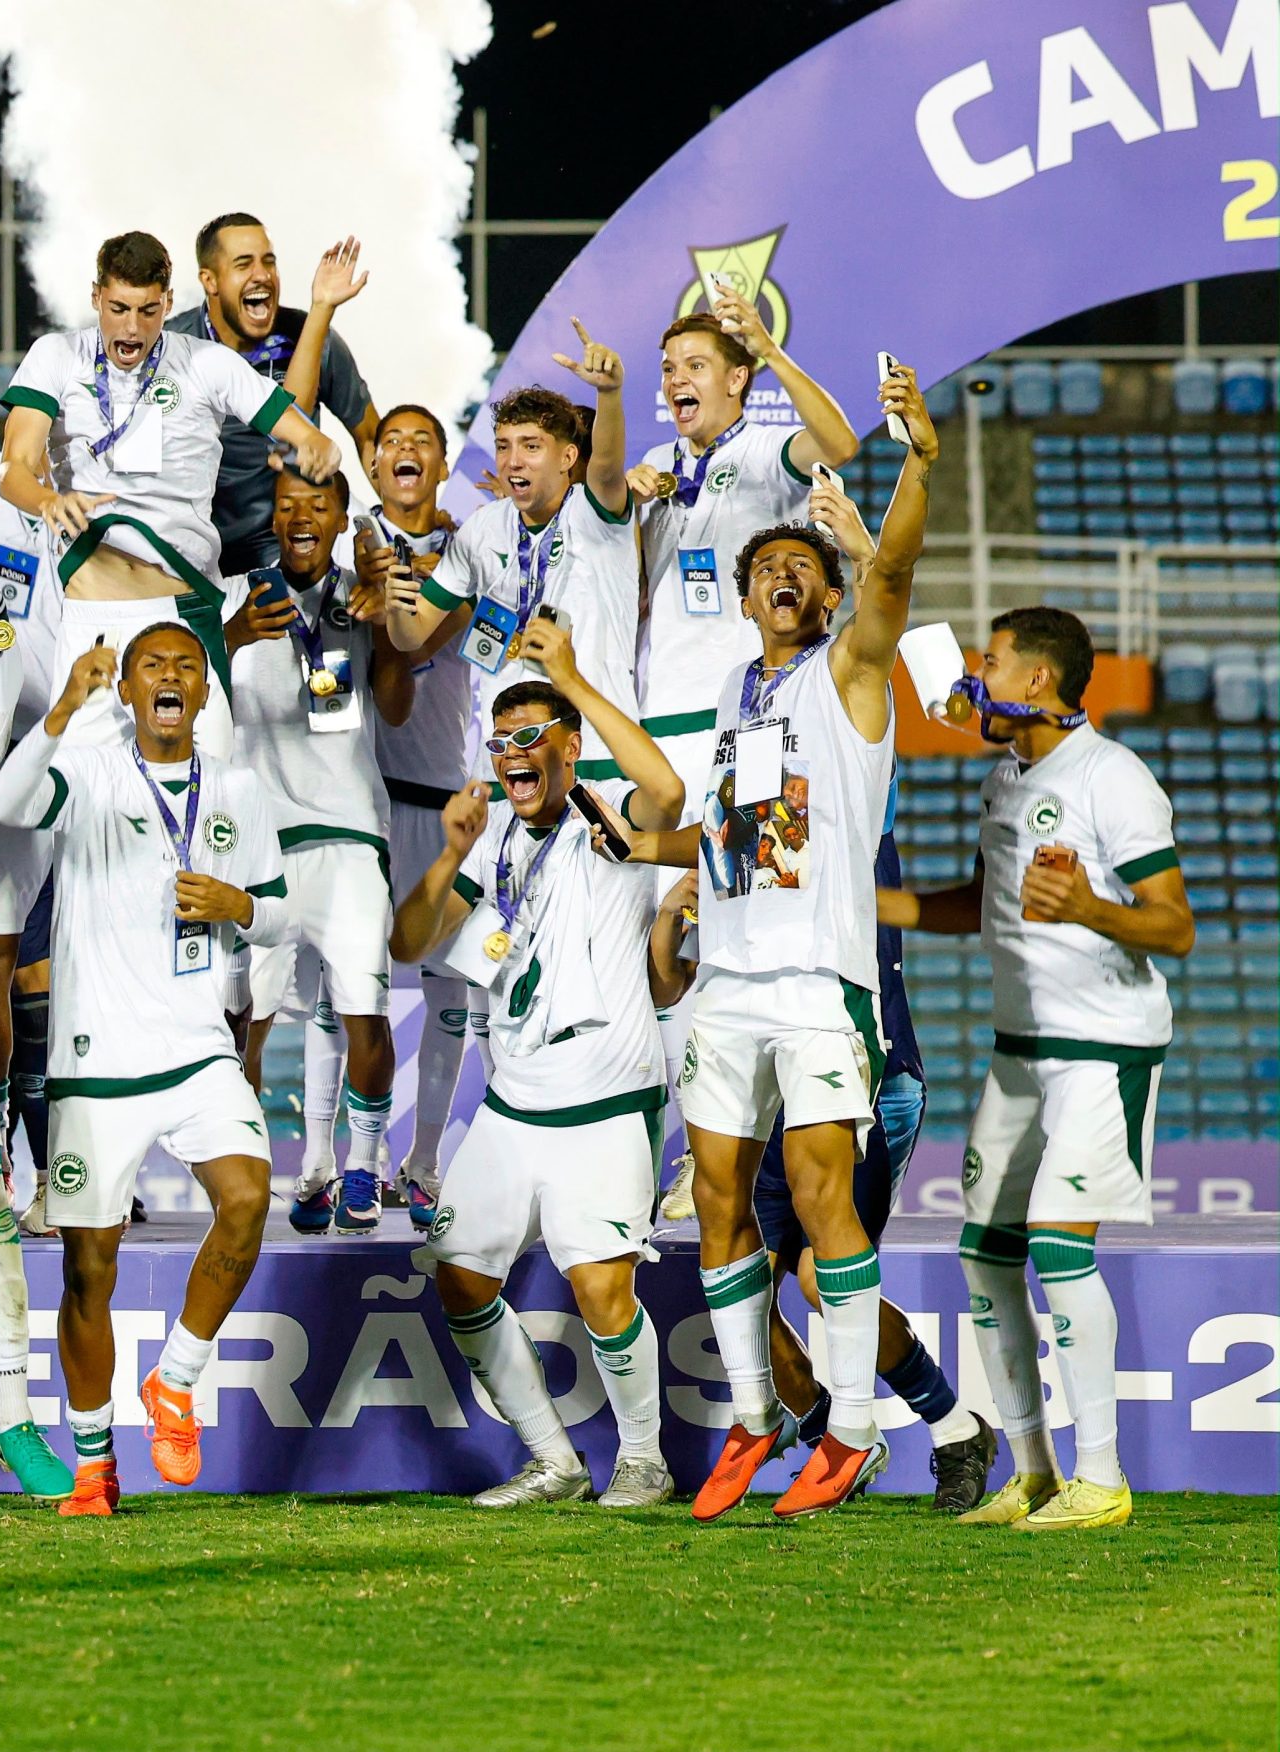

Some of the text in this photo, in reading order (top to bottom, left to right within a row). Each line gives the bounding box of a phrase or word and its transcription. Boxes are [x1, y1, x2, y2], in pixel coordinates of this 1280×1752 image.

[915, 0, 1280, 200] CAM
[1, 567, 26, 583] PÓDIO
[688, 570, 711, 580] PÓDIO
[479, 620, 503, 641] PÓDIO
[209, 819, 233, 848] G
[181, 924, 203, 938] PÓDIO
[56, 1160, 81, 1188] G
